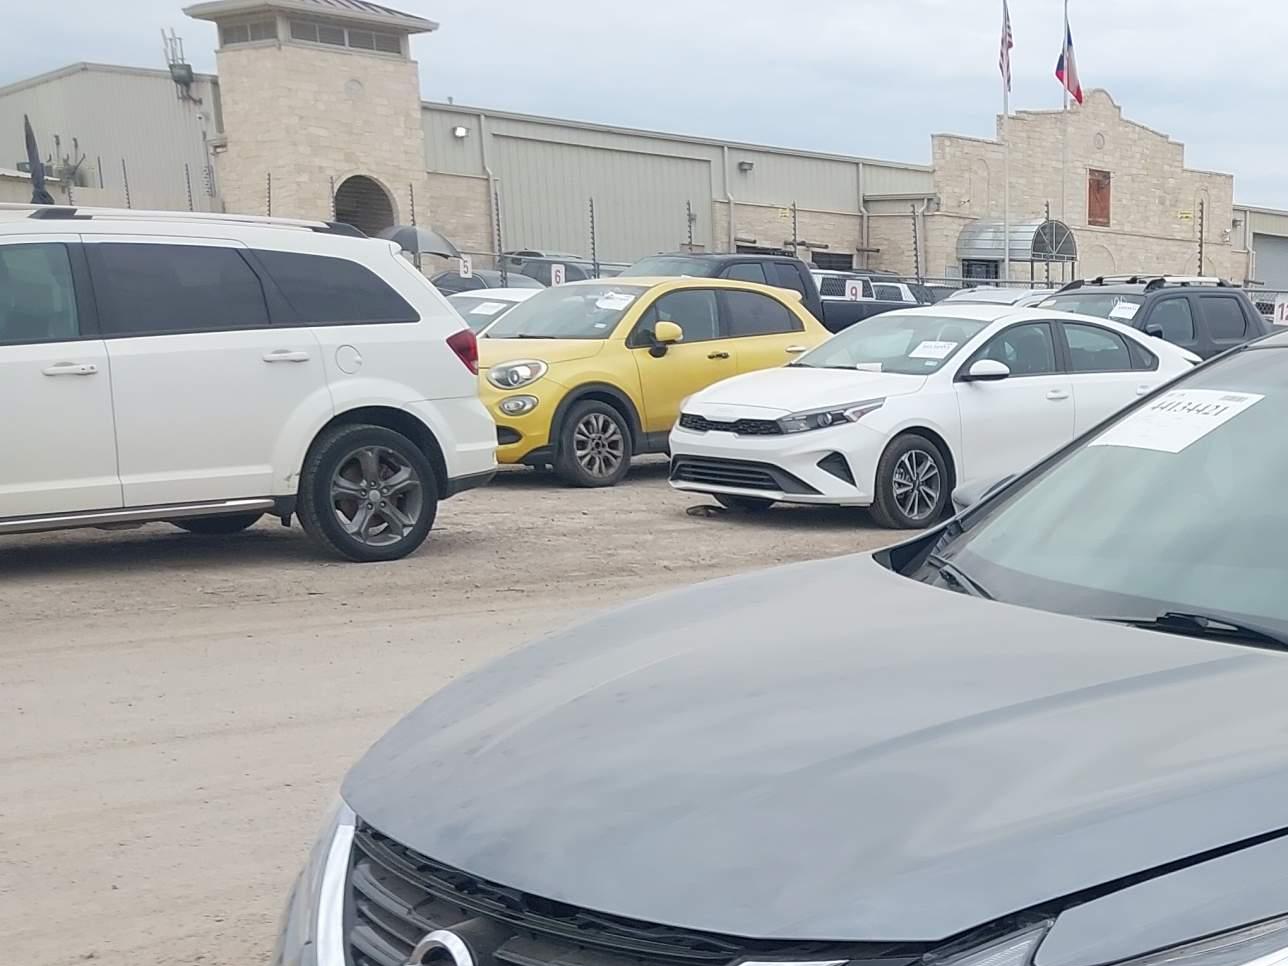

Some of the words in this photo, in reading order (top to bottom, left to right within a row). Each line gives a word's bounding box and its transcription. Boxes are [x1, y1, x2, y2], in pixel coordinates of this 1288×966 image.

[463, 260, 469, 275] 5
[555, 269, 561, 285] 6
[850, 286, 858, 302] 9
[1151, 400, 1230, 417] 44134421
